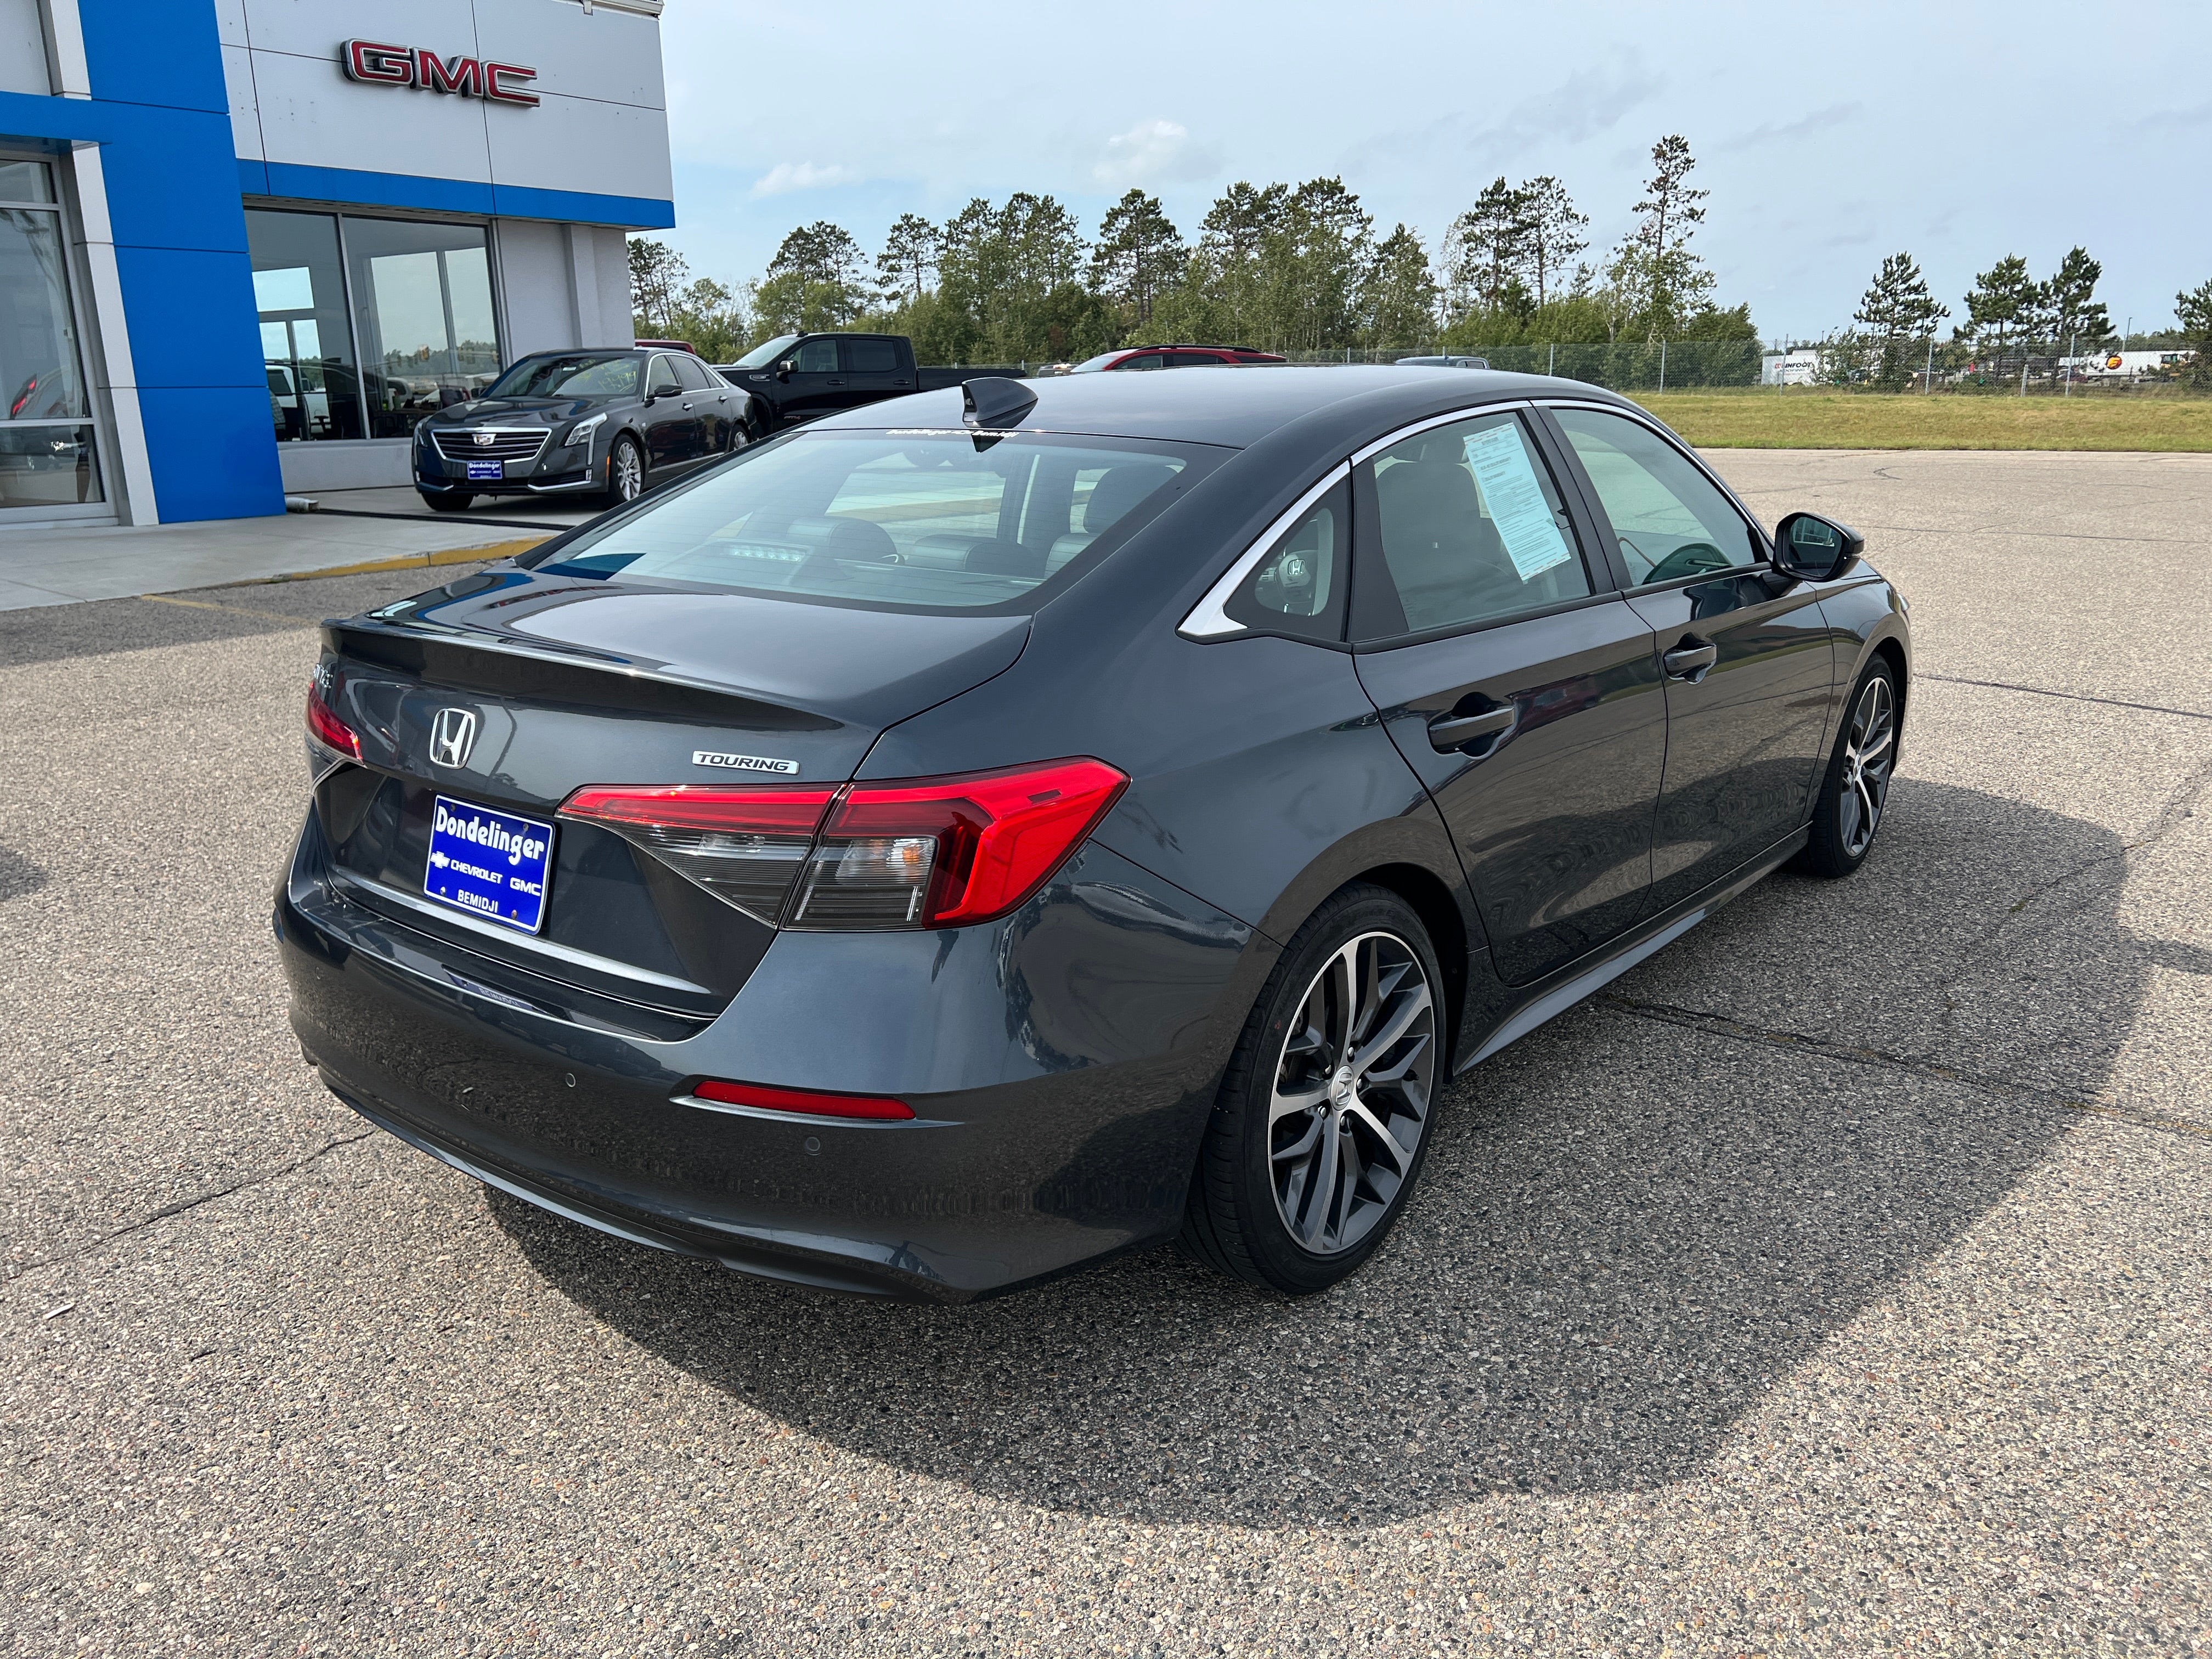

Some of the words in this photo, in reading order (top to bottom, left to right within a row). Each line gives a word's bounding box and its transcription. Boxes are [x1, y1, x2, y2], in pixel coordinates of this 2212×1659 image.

[340, 38, 540, 108] GMC
[698, 754, 790, 771] TOURING
[435, 805, 544, 866] Dondelinger
[450, 860, 503, 884] CHEVROLET
[510, 877, 541, 896] GMC
[458, 889, 498, 913] BEMIDJI
